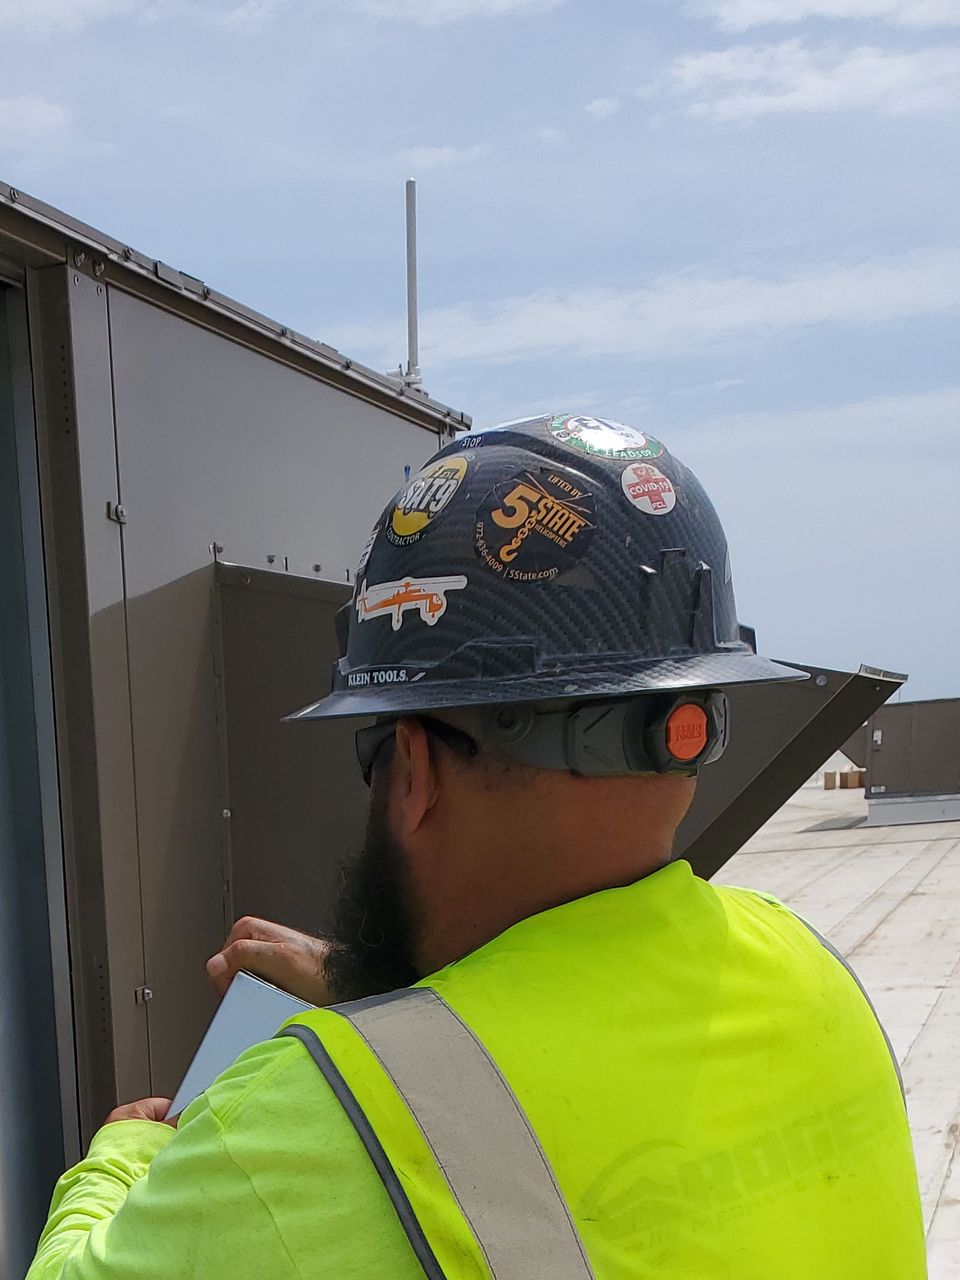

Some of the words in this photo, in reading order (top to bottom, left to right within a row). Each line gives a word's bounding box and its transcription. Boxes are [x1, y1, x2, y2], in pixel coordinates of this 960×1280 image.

[547, 474, 573, 493] LIFTED
[569, 487, 584, 499] BY
[630, 480, 671, 496] COVID-19
[491, 484, 542, 529] 5
[537, 498, 586, 542] STATE
[348, 672, 371, 687] KLEIN
[372, 669, 407, 684] TOOLS
